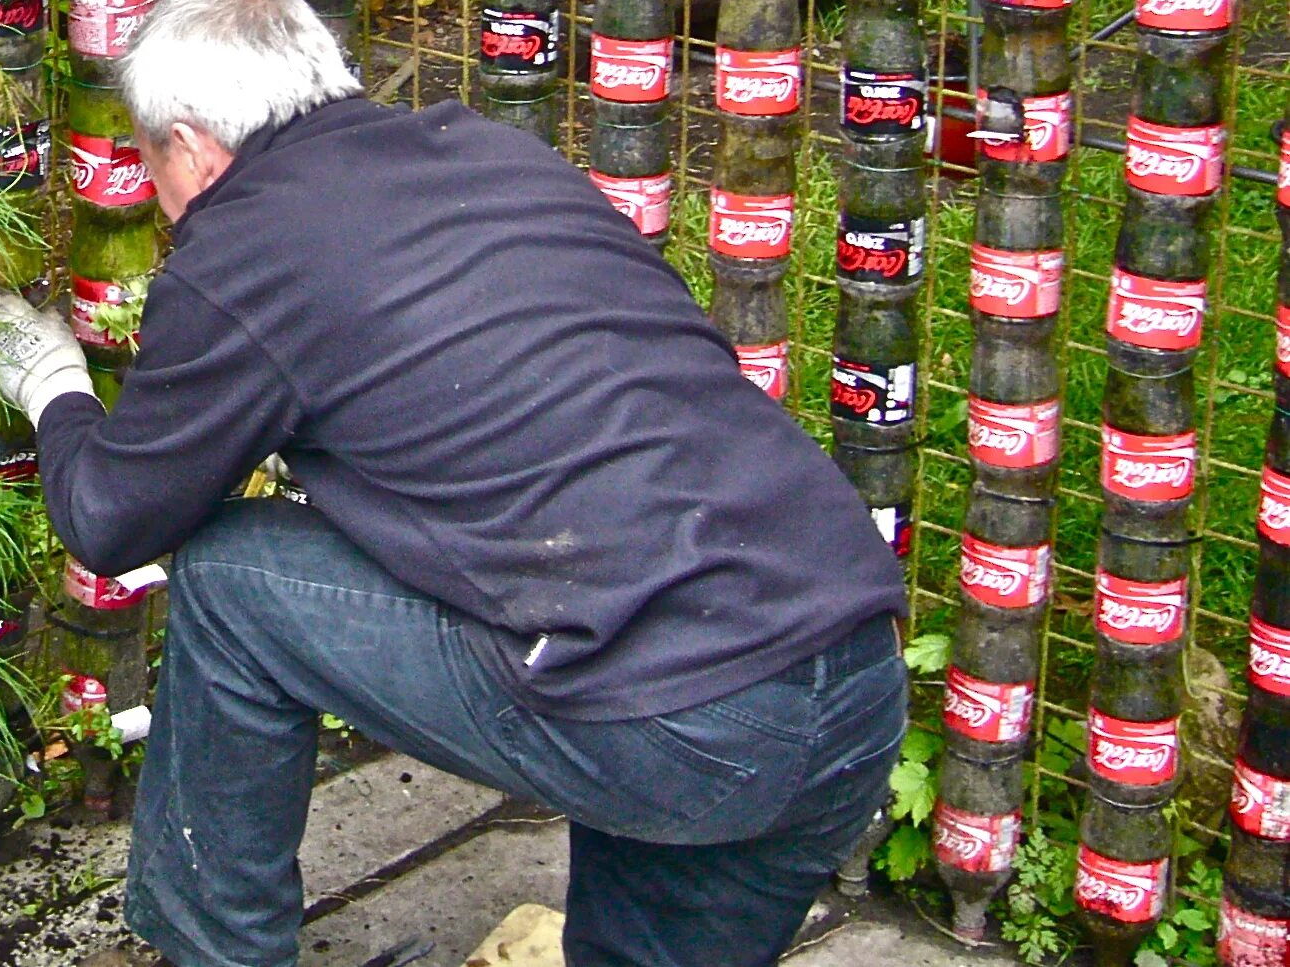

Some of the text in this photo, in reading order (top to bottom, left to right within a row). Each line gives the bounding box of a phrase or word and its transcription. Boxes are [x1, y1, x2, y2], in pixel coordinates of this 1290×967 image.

[491, 22, 525, 35] zero
[595, 61, 659, 87] Coca-Cola
[726, 76, 793, 102] Coca-Cola
[860, 85, 901, 99] zero
[848, 98, 917, 124] Coca-Cola
[1129, 147, 1199, 183] Coca-Cola
[719, 218, 786, 245] Coca-Cola
[846, 232, 886, 249] zero
[1120, 300, 1197, 336] Coca-Cola
[1117, 454, 1189, 488] Coca-Cola
[1100, 598, 1177, 632] Coca-Cola
[1094, 739, 1168, 774] Coca-Cola
